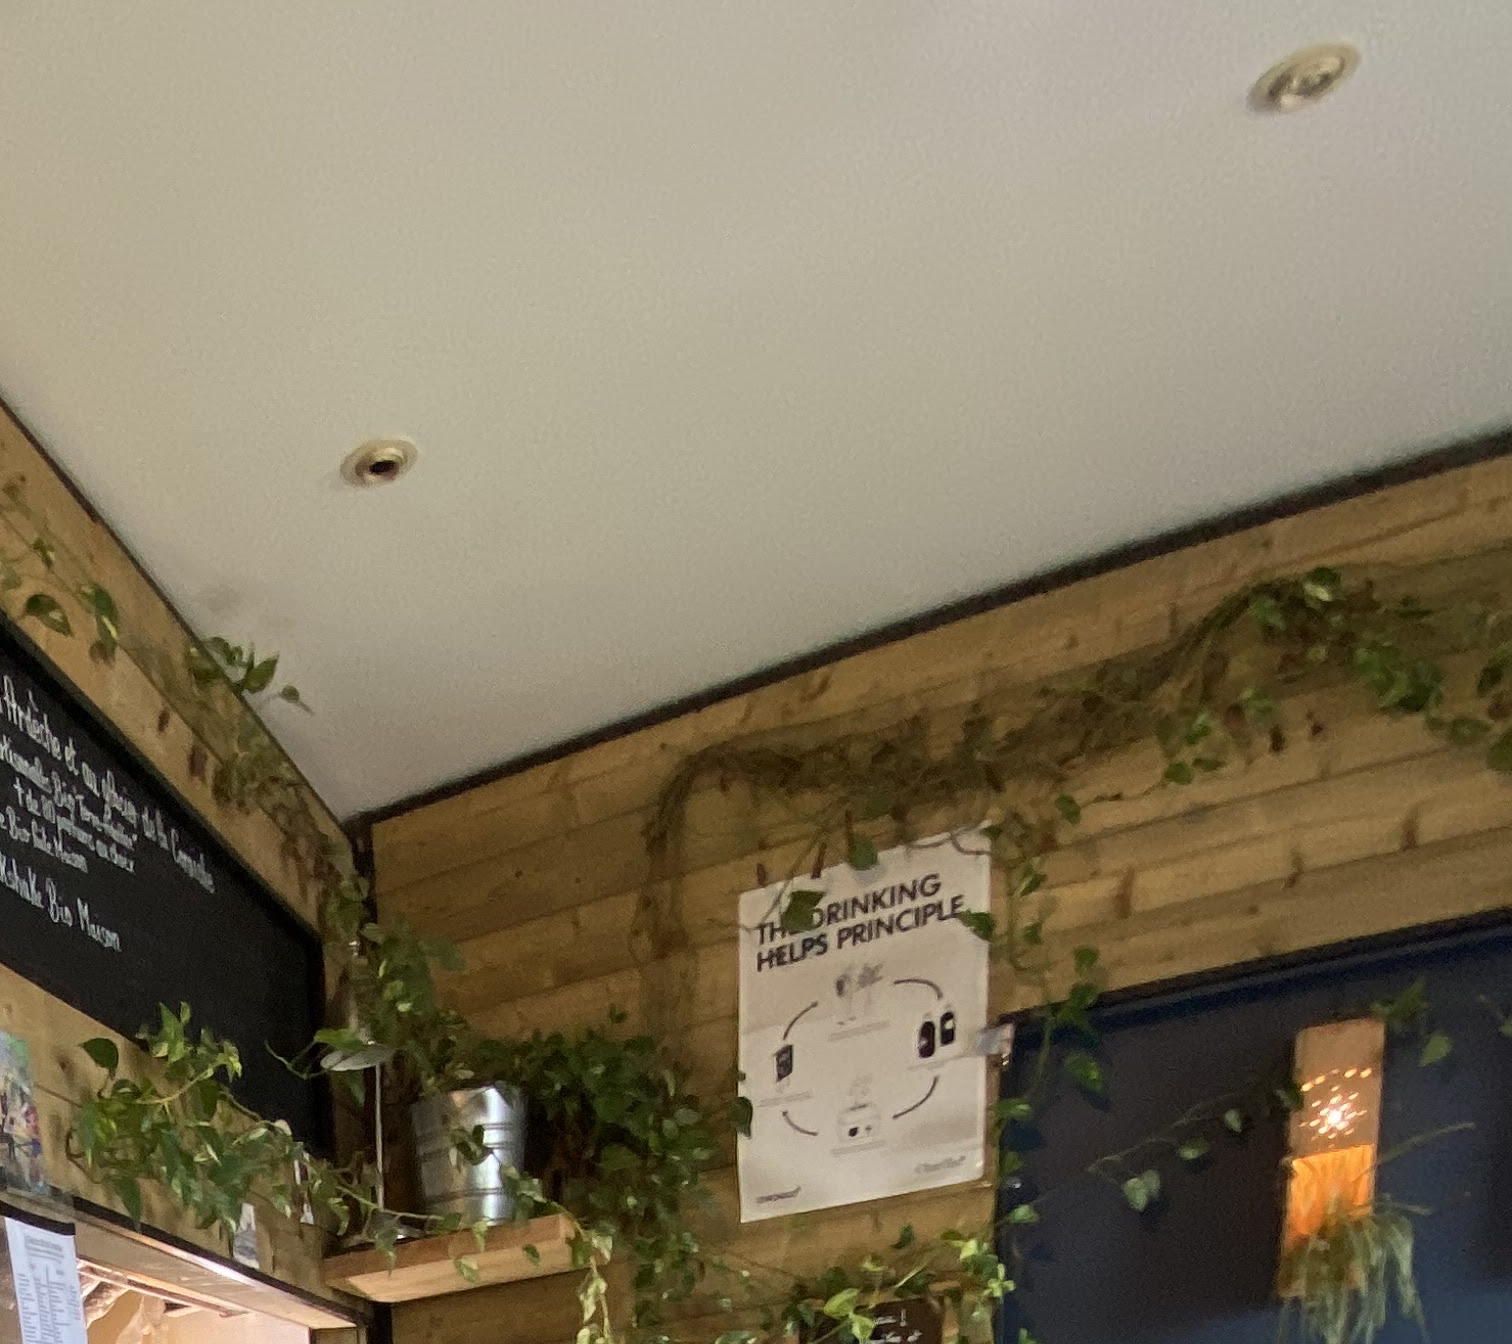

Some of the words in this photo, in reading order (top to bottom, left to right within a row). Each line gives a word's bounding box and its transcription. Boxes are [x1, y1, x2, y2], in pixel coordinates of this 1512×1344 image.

[756, 932, 829, 972] HELPS
[837, 894, 966, 951] PRINCIPLE
[810, 872, 942, 929] DRINKING
